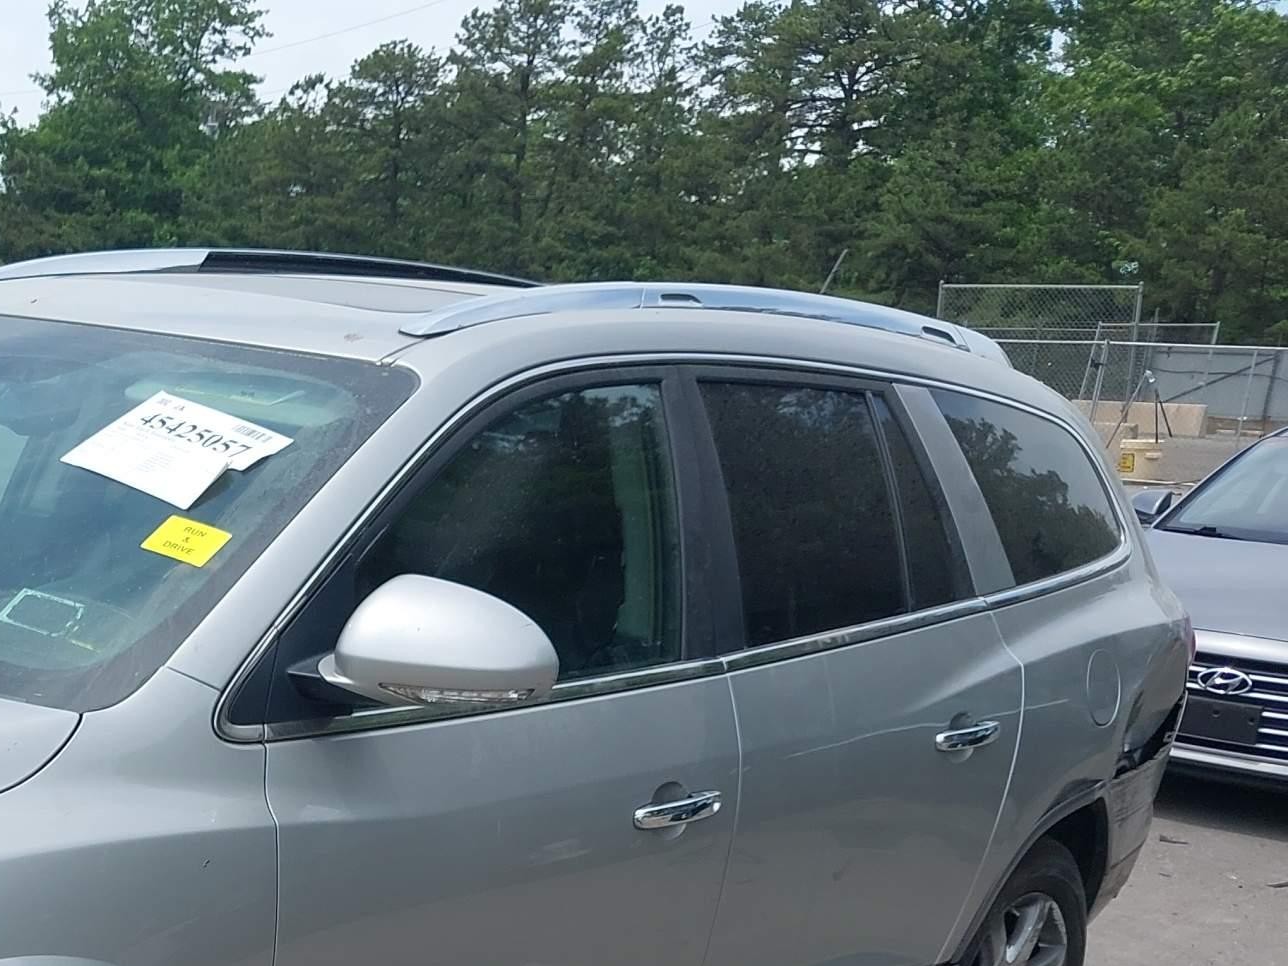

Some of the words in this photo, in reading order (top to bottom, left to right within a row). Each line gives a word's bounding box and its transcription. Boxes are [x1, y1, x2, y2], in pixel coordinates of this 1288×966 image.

[140, 413, 253, 457] 45425057
[183, 526, 207, 537] RUN
[162, 540, 196, 554] DRIVE
